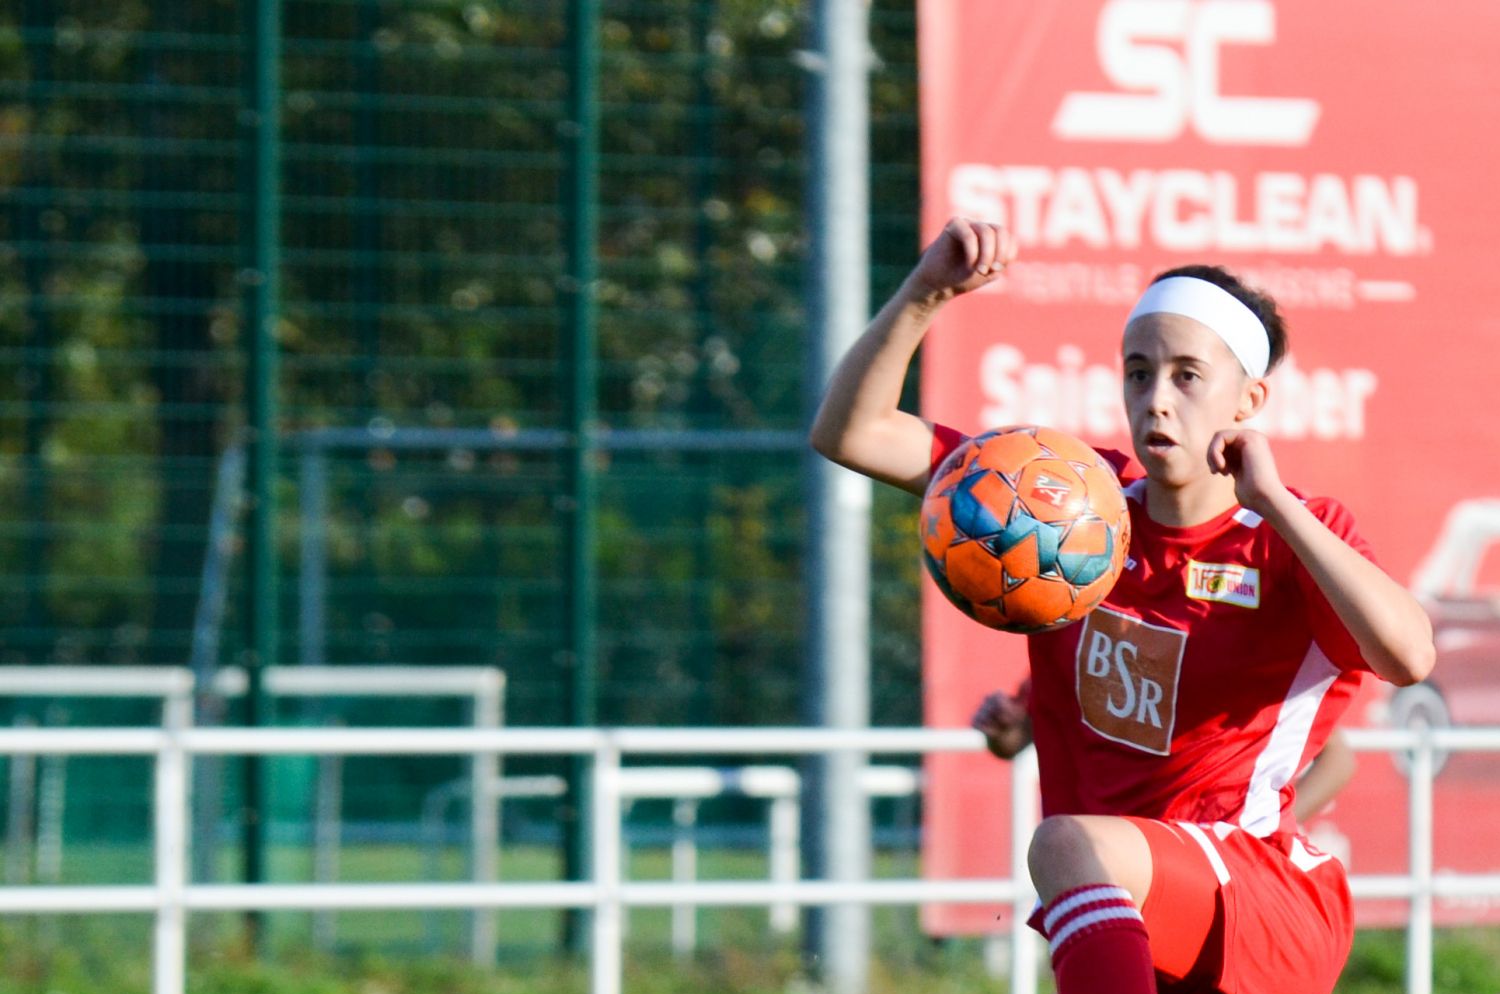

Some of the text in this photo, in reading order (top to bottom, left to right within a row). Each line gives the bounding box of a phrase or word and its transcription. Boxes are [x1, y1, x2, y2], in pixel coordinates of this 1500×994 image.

[1051, 0, 1321, 147] SC
[948, 163, 1420, 254] STAYCLEAN
[1226, 580, 1256, 598] UNION
[1087, 630, 1163, 729] BSR
